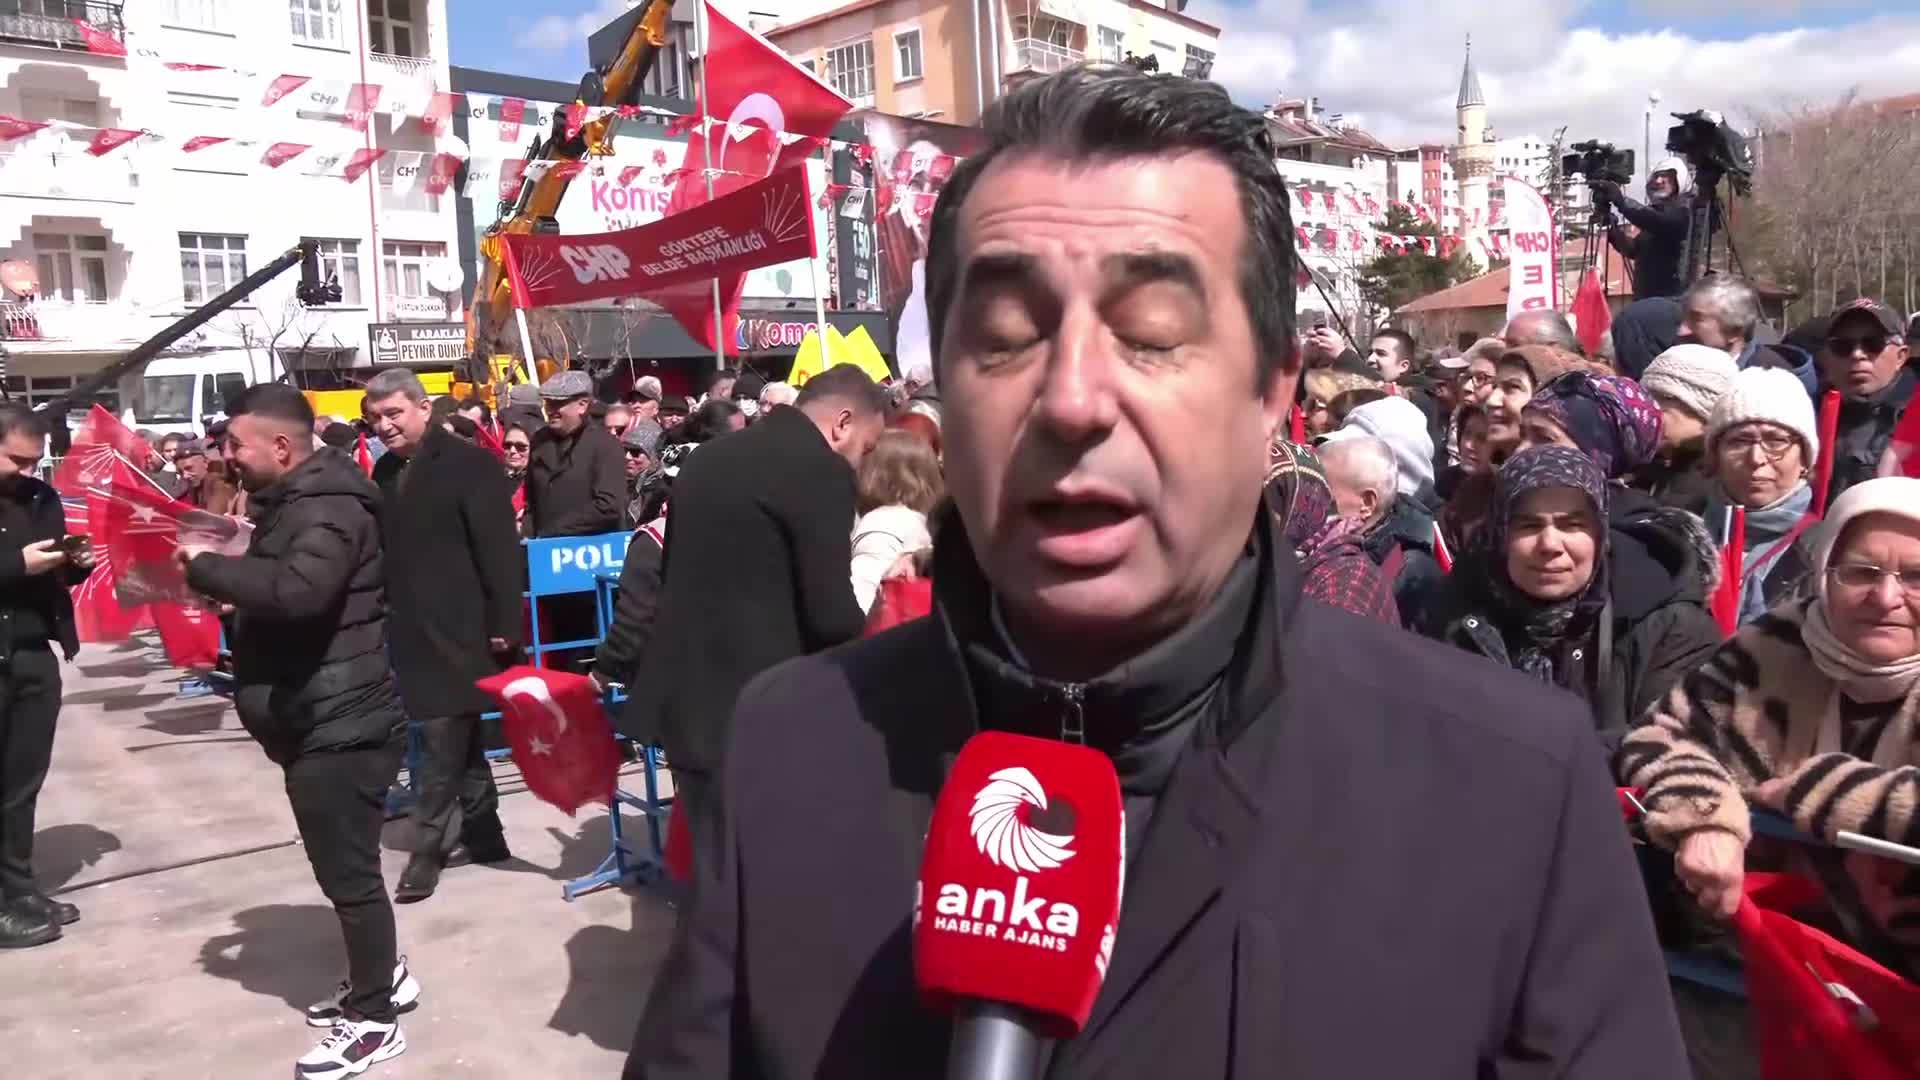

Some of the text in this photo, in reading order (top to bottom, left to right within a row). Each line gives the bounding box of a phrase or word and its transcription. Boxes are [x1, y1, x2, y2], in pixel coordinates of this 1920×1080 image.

[640, 232, 768, 277] BELDE BAŞKANLIĞI
[659, 226, 730, 258] GÖKTEPE
[559, 243, 632, 285] CHP
[402, 343, 436, 360] PEYNİR
[936, 876, 1079, 938] anka
[934, 916, 1067, 952] HABER AJANS
